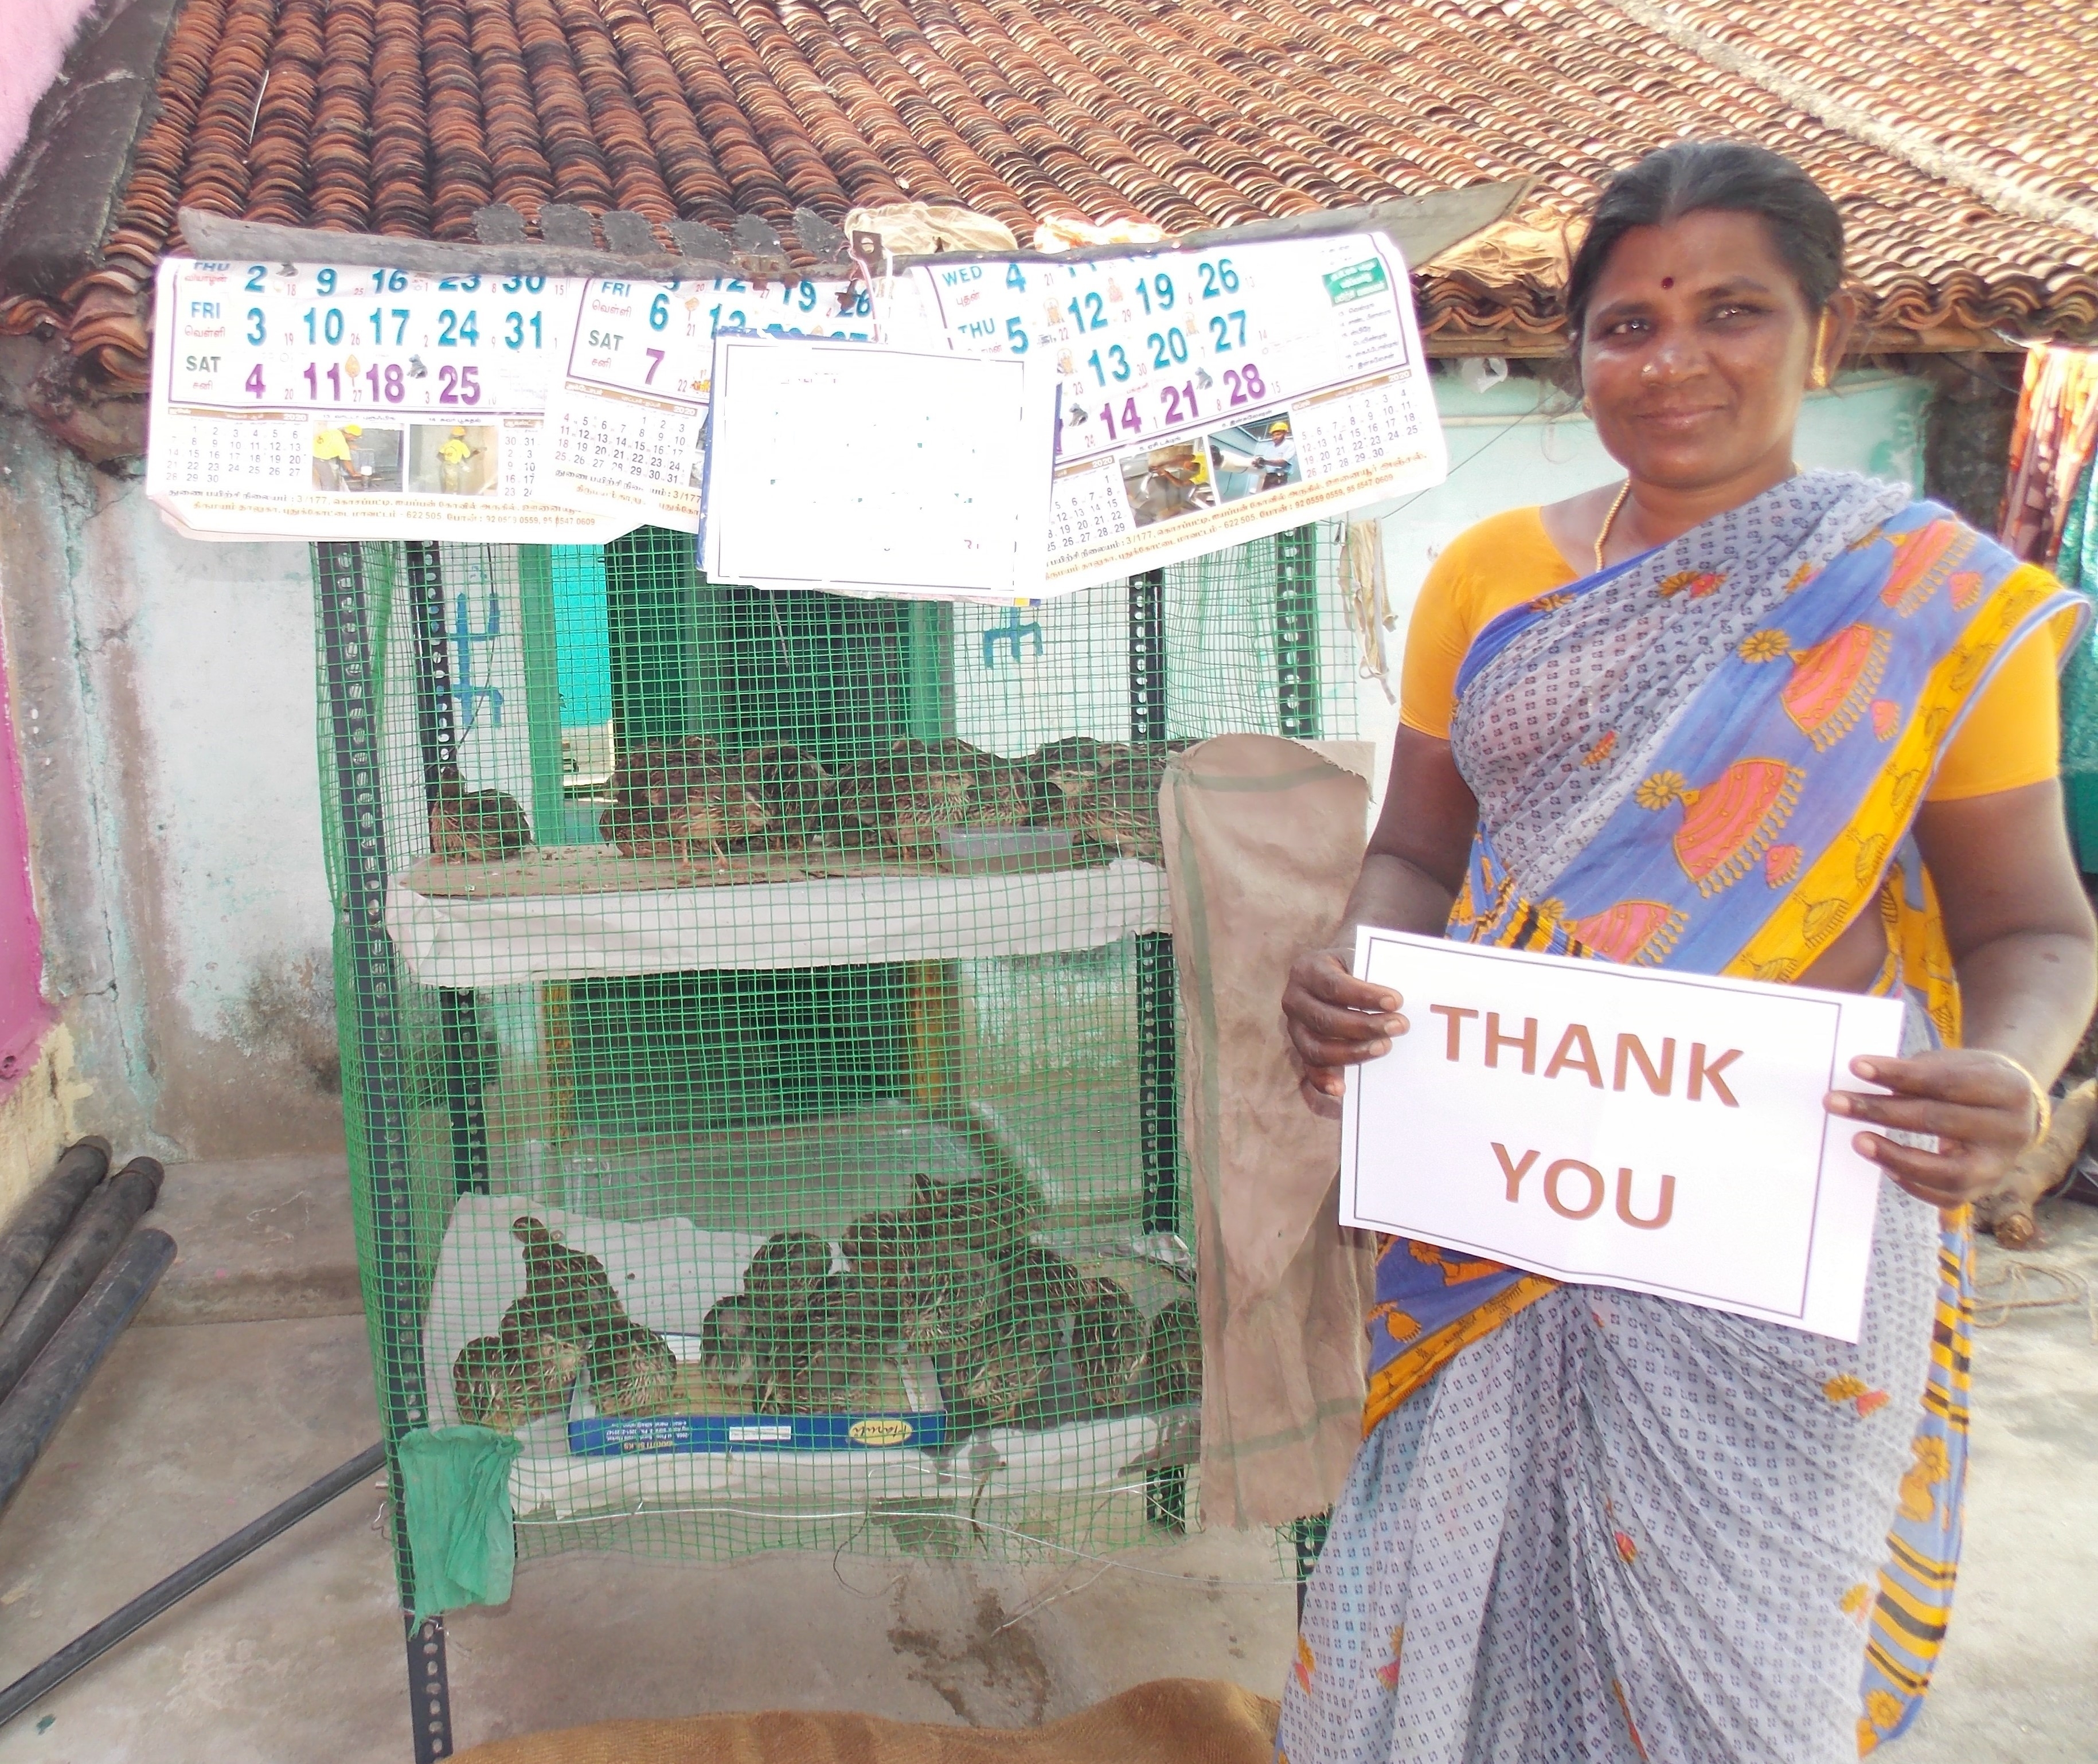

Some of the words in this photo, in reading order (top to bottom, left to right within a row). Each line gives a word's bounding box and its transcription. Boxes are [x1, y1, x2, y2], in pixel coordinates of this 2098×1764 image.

[193, 263, 230, 271] THU
[245, 265, 268, 293] 2
[317, 268, 338, 297] 9
[372, 269, 409, 294] 16
[502, 275, 546, 295] 30
[287, 284, 296, 296] 18
[942, 265, 982, 287] WED
[1006, 263, 1026, 294] 4
[1067, 292, 1109, 335] 12
[1136, 273, 1175, 316] 19
[1198, 259, 1239, 300] 26
[191, 302, 221, 319] FRI
[247, 308, 267, 346] 3
[303, 307, 345, 346] 10
[370, 307, 411, 346] 17
[438, 310, 480, 347] 24
[505, 311, 542, 350] 31
[602, 281, 631, 298] FRI
[650, 294, 670, 332] 6
[588, 330, 624, 351] SAT
[645, 348, 665, 385] 7
[1006, 316, 1029, 354] 5
[1088, 345, 1131, 388] 13
[1147, 327, 1188, 371] 20
[1209, 310, 1247, 354] 27
[186, 356, 221, 373] SAT
[245, 364, 266, 399] 4
[303, 362, 341, 401] 11
[366, 363, 405, 403] 18
[439, 365, 480, 405] 25
[1388, 371, 1410, 382] 2020
[674, 405, 696, 416] 2020
[1100, 397, 1142, 441] 14
[1161, 380, 1199, 425] 21
[1223, 363, 1266, 406] 28
[1092, 457, 1113, 468] 2020
[1224, 518, 1239, 529] 622
[1429, 1002, 1744, 1109] THANK
[1488, 1140, 1677, 1231] YOU
